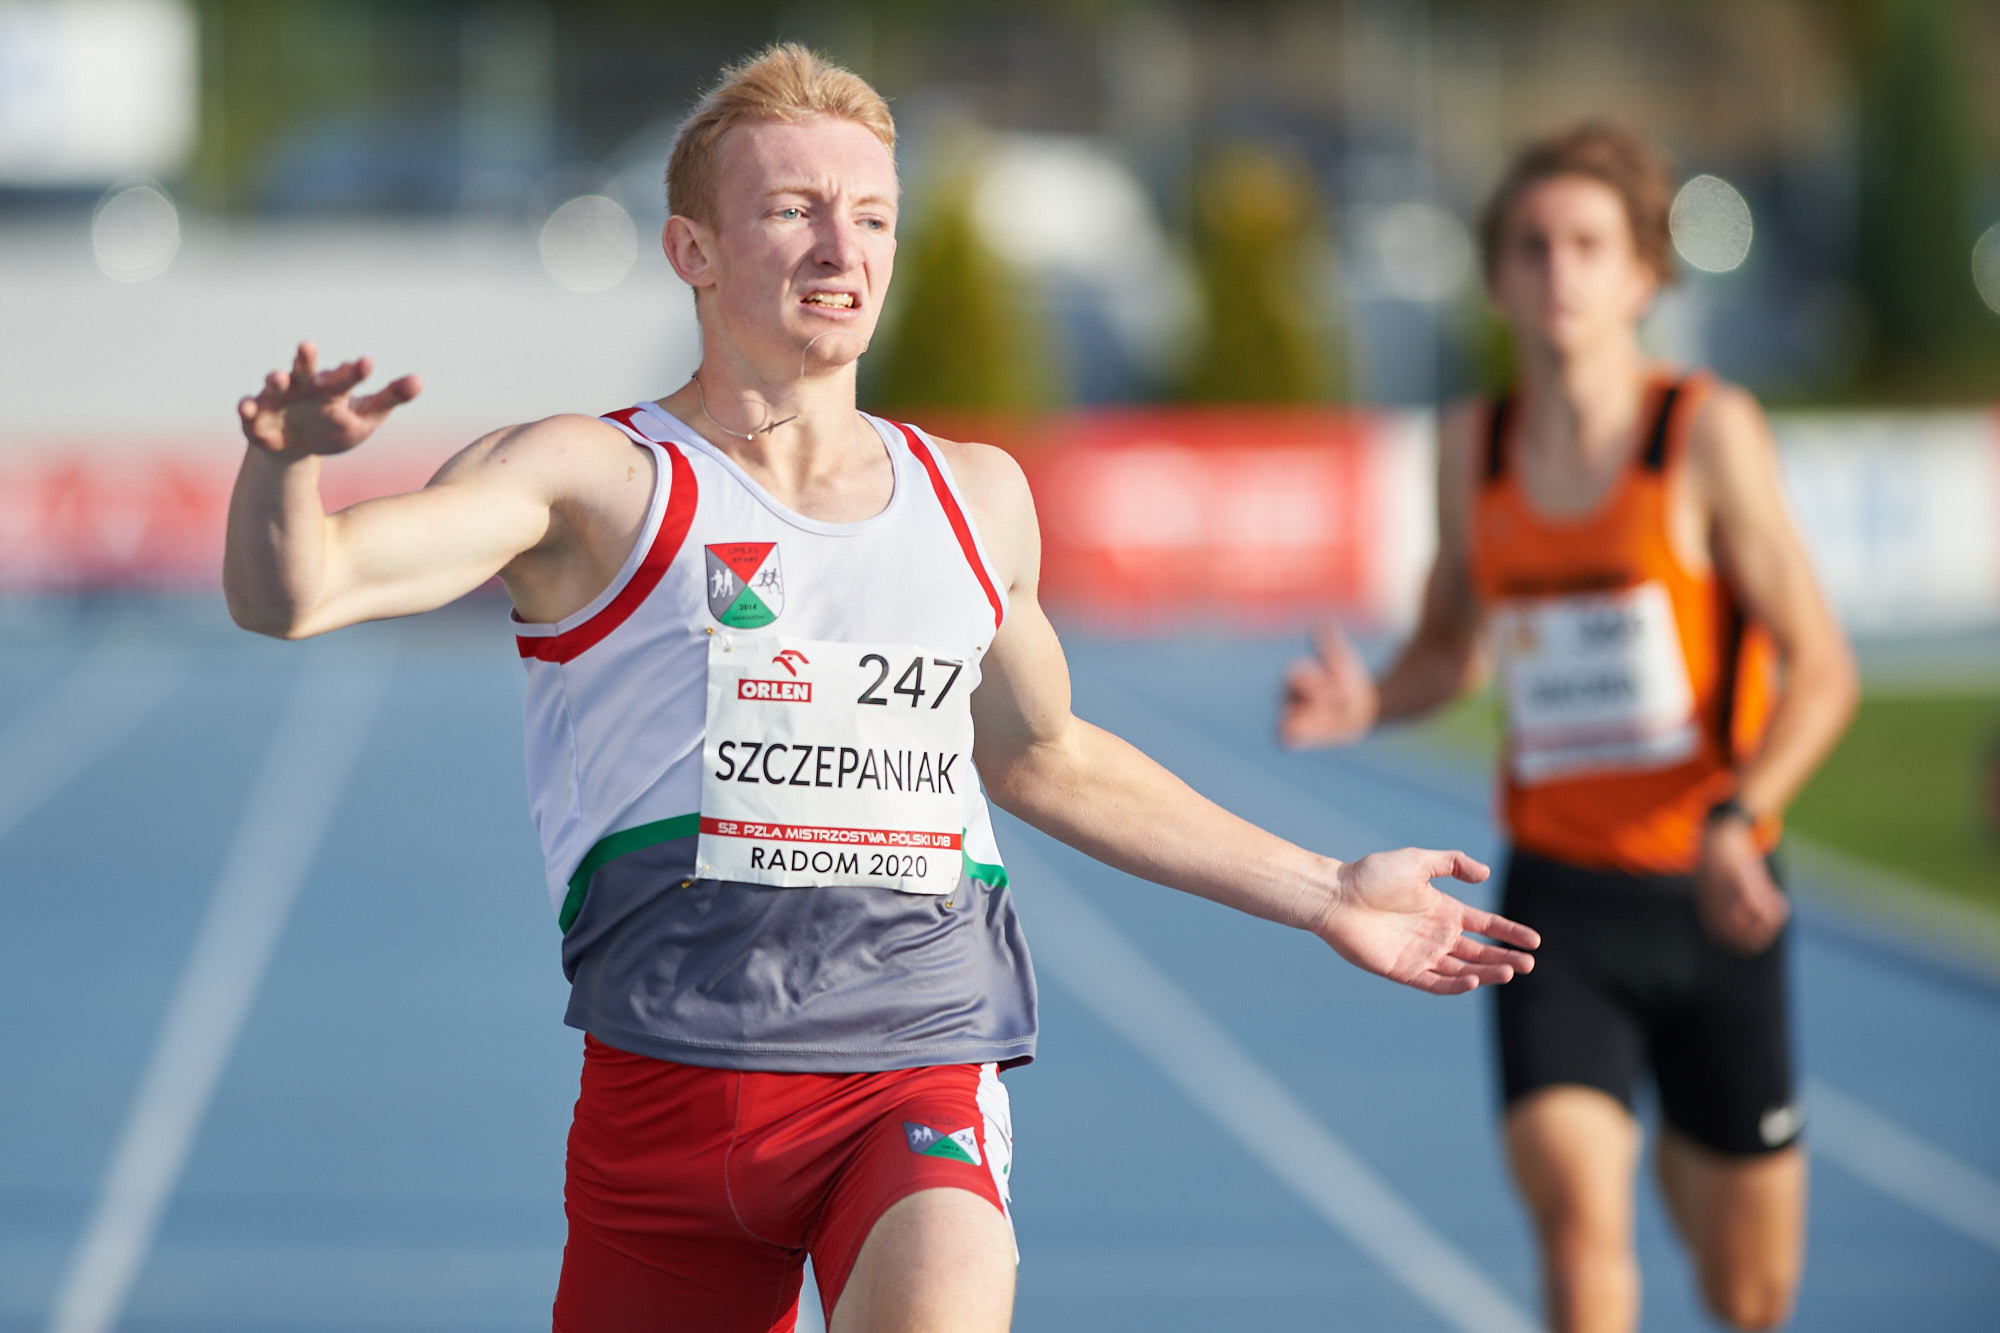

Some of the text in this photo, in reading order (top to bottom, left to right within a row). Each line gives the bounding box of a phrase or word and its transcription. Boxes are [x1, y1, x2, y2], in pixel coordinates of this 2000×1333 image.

[741, 681, 809, 701] ORLEN
[857, 653, 964, 710] 247
[715, 740, 959, 795] SZCZEPANIAK
[717, 821, 952, 848] 52. PZLA MISTRZOSTWA POLSKI U18
[750, 846, 928, 878] RADOM 2020
